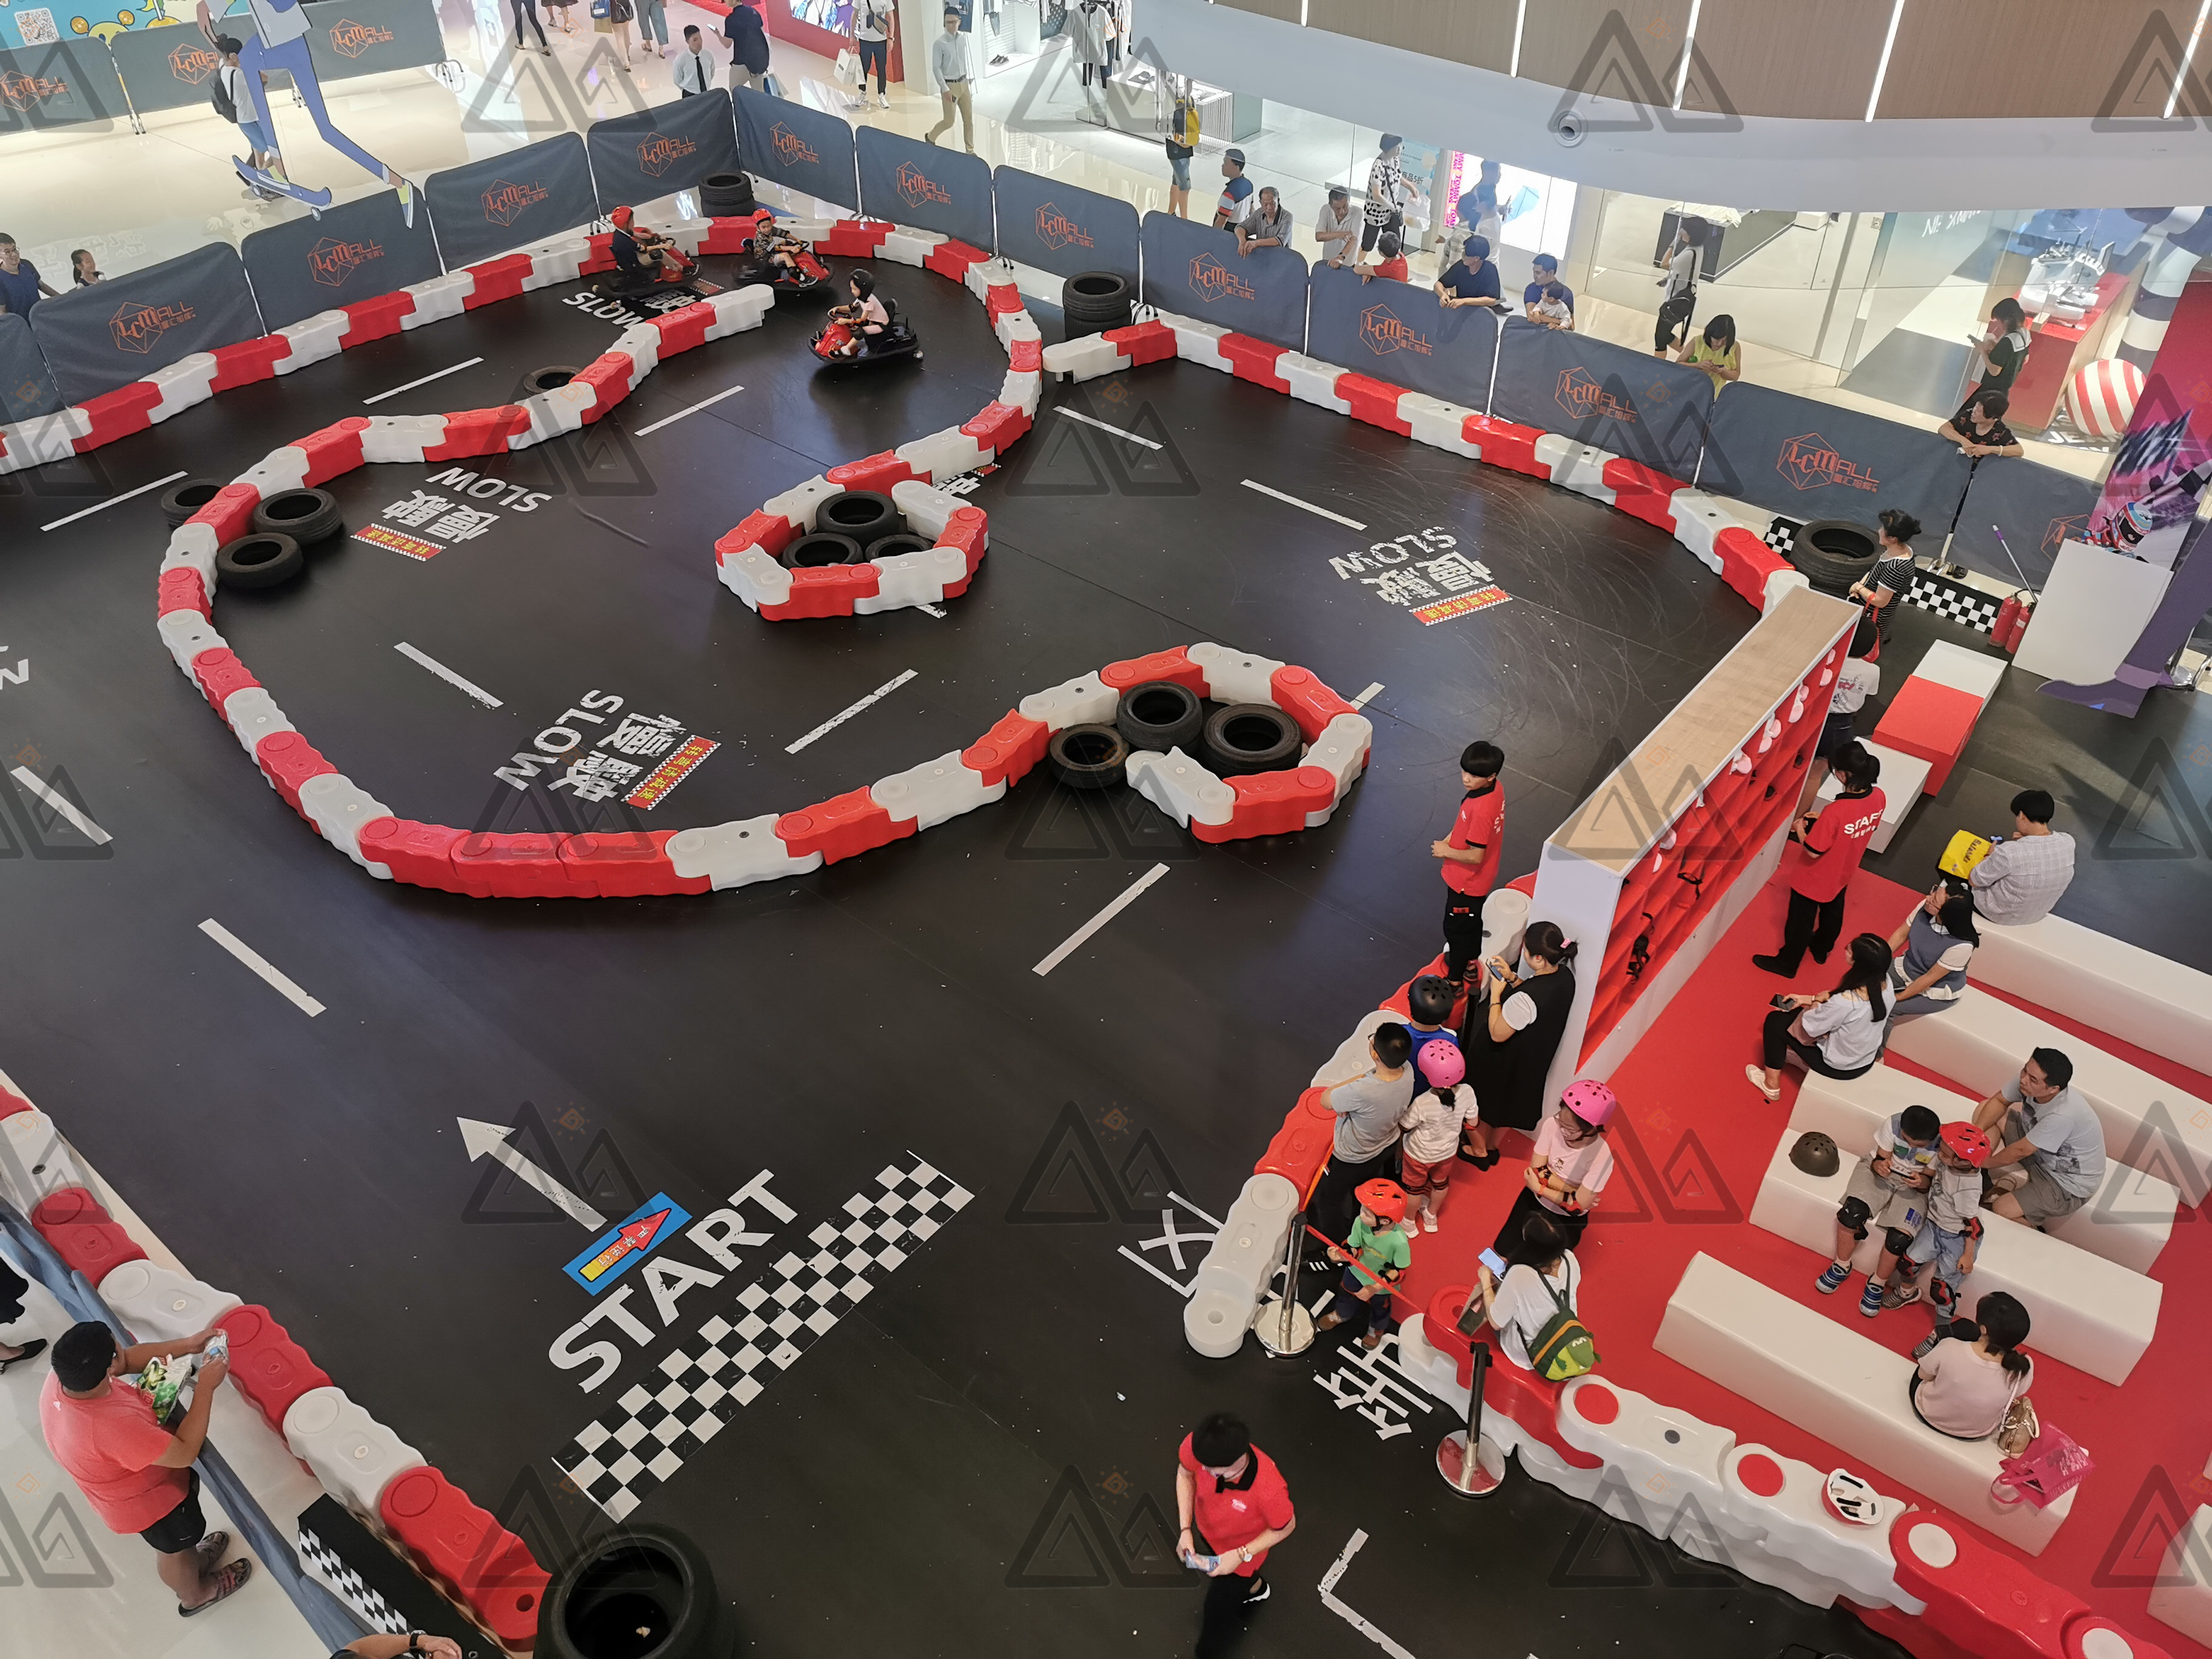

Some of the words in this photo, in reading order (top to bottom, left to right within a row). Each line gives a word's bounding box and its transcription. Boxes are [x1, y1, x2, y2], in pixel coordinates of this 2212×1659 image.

[426, 467, 552, 512] SLOW
[1329, 526, 1457, 580] SLOW
[494, 689, 624, 791] SLOW
[549, 1168, 799, 1394] START
